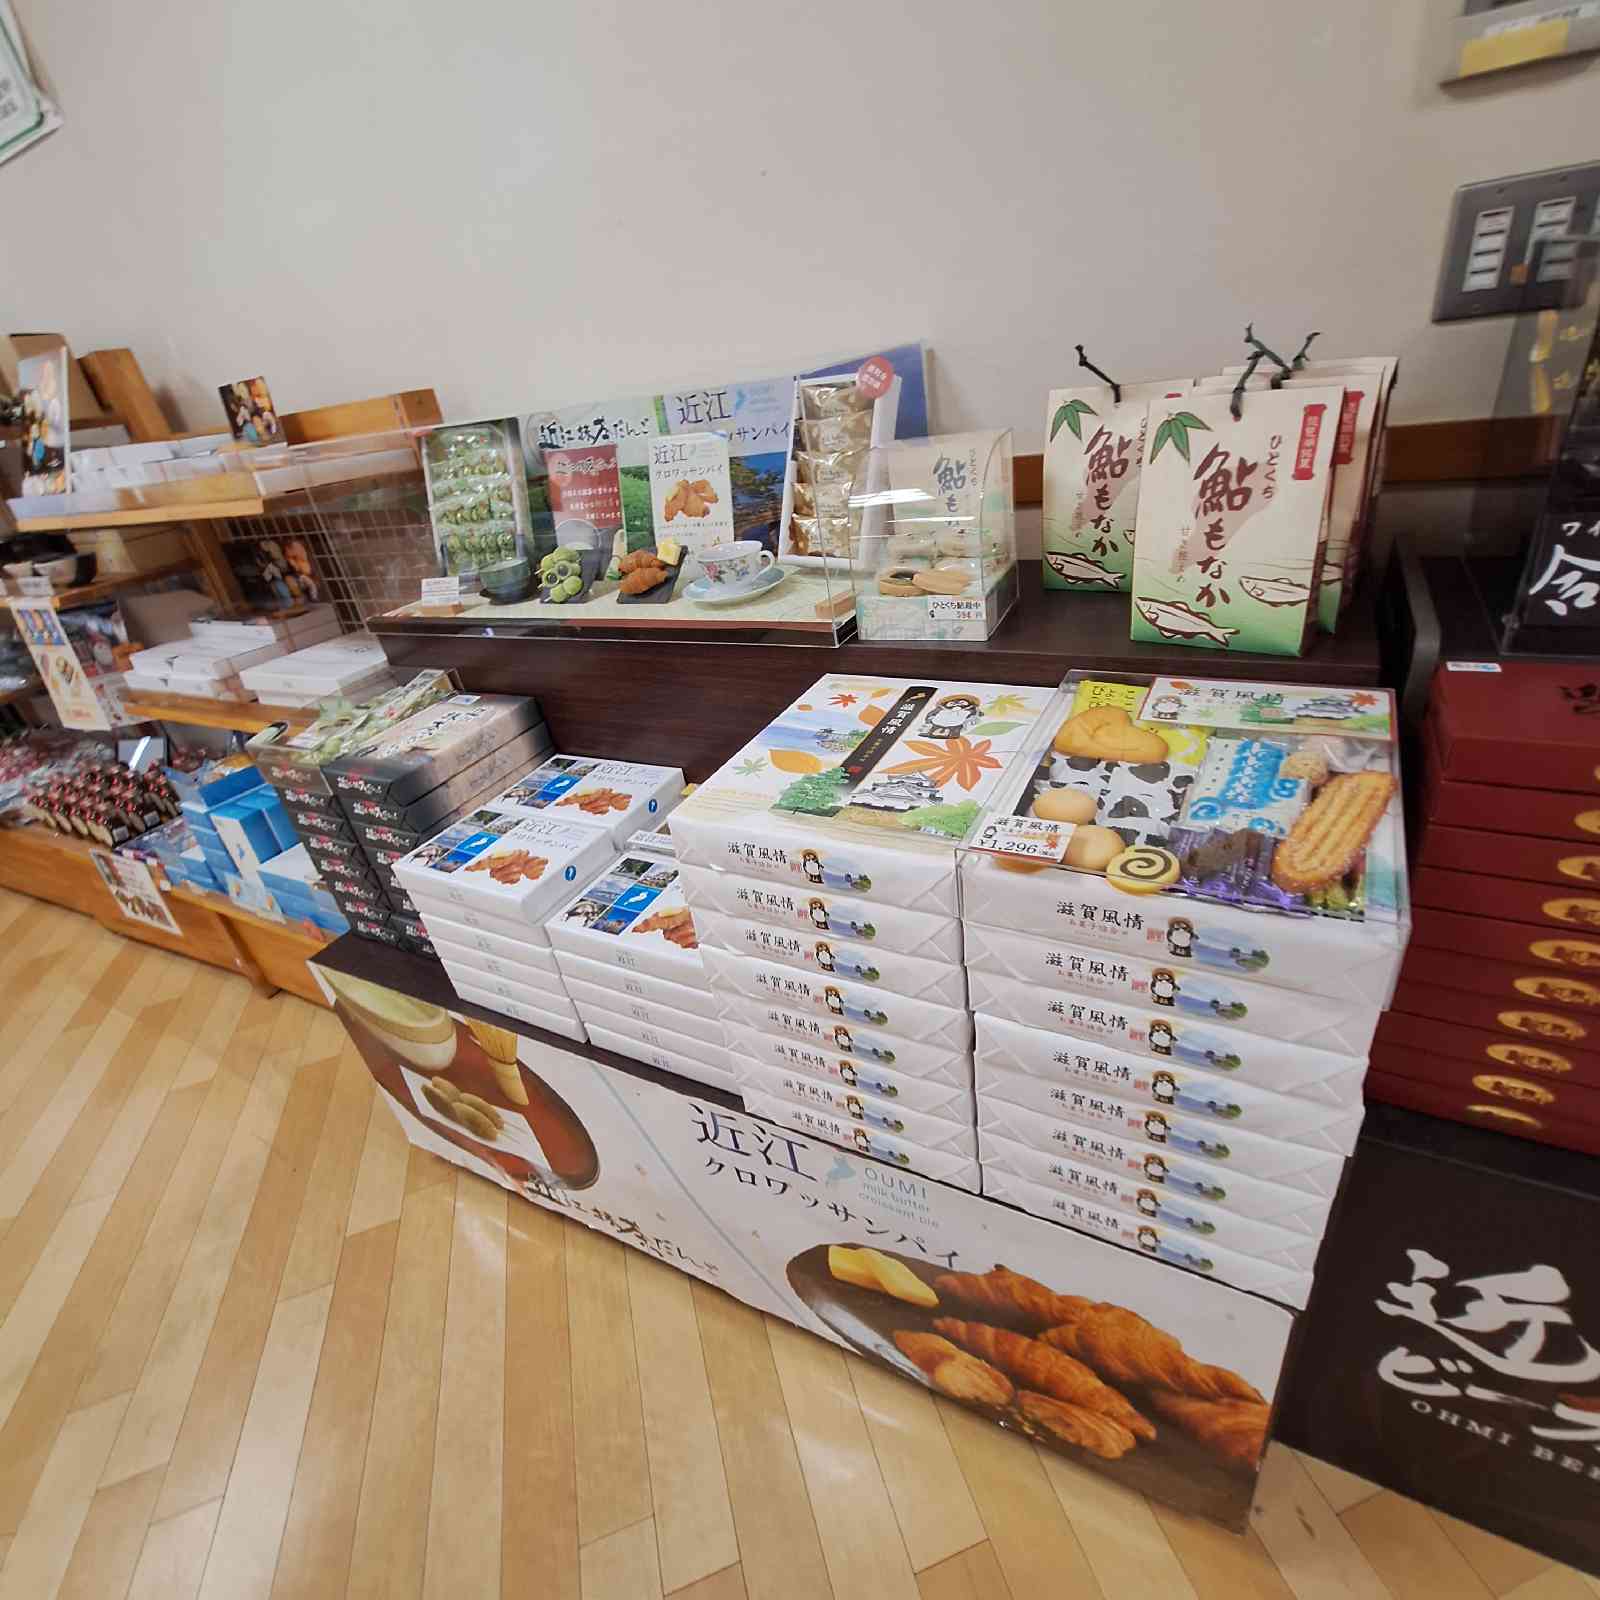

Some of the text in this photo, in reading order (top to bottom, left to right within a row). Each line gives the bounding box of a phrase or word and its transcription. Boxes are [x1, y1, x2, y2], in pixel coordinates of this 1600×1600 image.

[676, 391, 732, 424] 近江
[1262, 434, 1282, 500] ひとくち
[1083, 424, 1132, 556] 鮎もなか
[1193, 443, 1258, 607] 鮎もなか
[1179, 688, 1284, 703] 滋賀風情
[727, 841, 788, 864] 滋賀風情
[736, 887, 795, 912] 滋賀風情
[1056, 900, 1145, 931] 滋賀風情
[1045, 951, 1129, 982] 滋賀風情
[1047, 998, 1129, 1031] 滋賀風情
[1053, 1049, 1132, 1082] 滋賀風情
[1050, 1086, 1126, 1120] 滋賀風情
[688, 1102, 818, 1182] 近江
[864, 1167, 926, 1199] OUMI
[705, 1156, 960, 1268] クロワッサンパイ
[1411, 1400, 1514, 1446] OHMI
